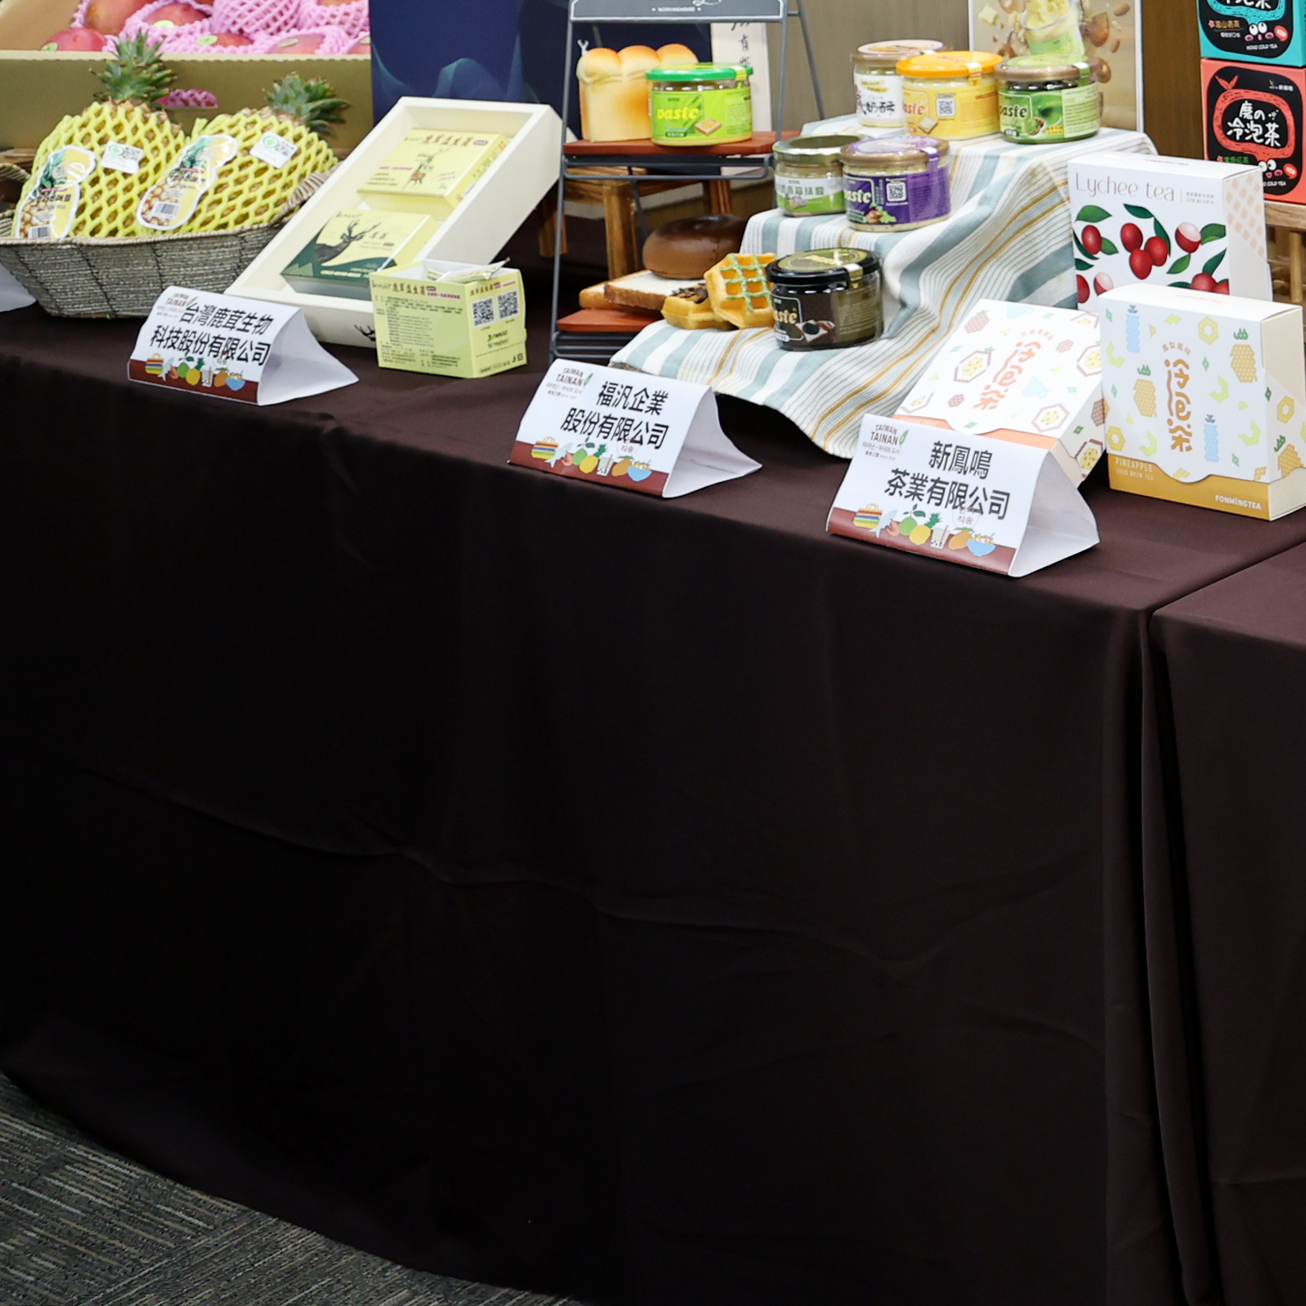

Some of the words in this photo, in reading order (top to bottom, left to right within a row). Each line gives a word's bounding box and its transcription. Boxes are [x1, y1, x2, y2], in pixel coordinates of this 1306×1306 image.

[1226, 119, 1282, 148] 冷泡茶
[1075, 172, 1139, 198] Lychee
[1145, 183, 1175, 202] tea
[178, 302, 275, 336] 台灣鹿茸生物
[149, 324, 272, 366] 科技股份有限公司
[555, 373, 585, 387] TAINAN
[596, 380, 669, 417] 福汎企業
[560, 407, 670, 450] 股份有限公司
[870, 431, 899, 446] TAINAN
[928, 440, 993, 480] 新鳳鳴
[884, 467, 1011, 521] 茶業有限公司
